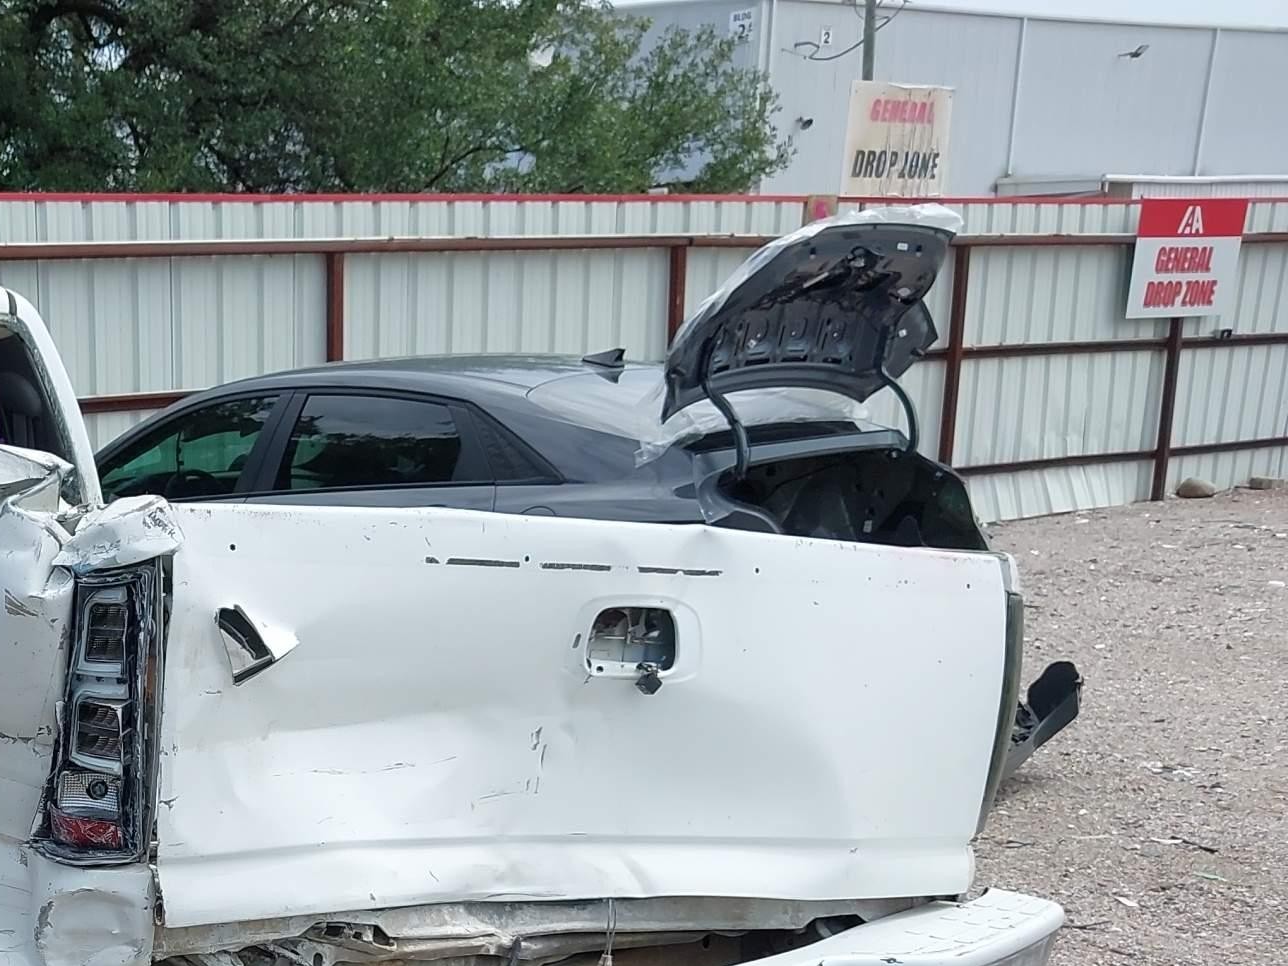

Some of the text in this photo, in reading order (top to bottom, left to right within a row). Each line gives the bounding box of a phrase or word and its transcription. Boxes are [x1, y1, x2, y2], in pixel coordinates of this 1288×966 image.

[823, 31, 831, 44] 2
[851, 149, 899, 178] DROP
[1155, 246, 1214, 274] GENERAL
[1143, 279, 1218, 308] DROP ZONE
